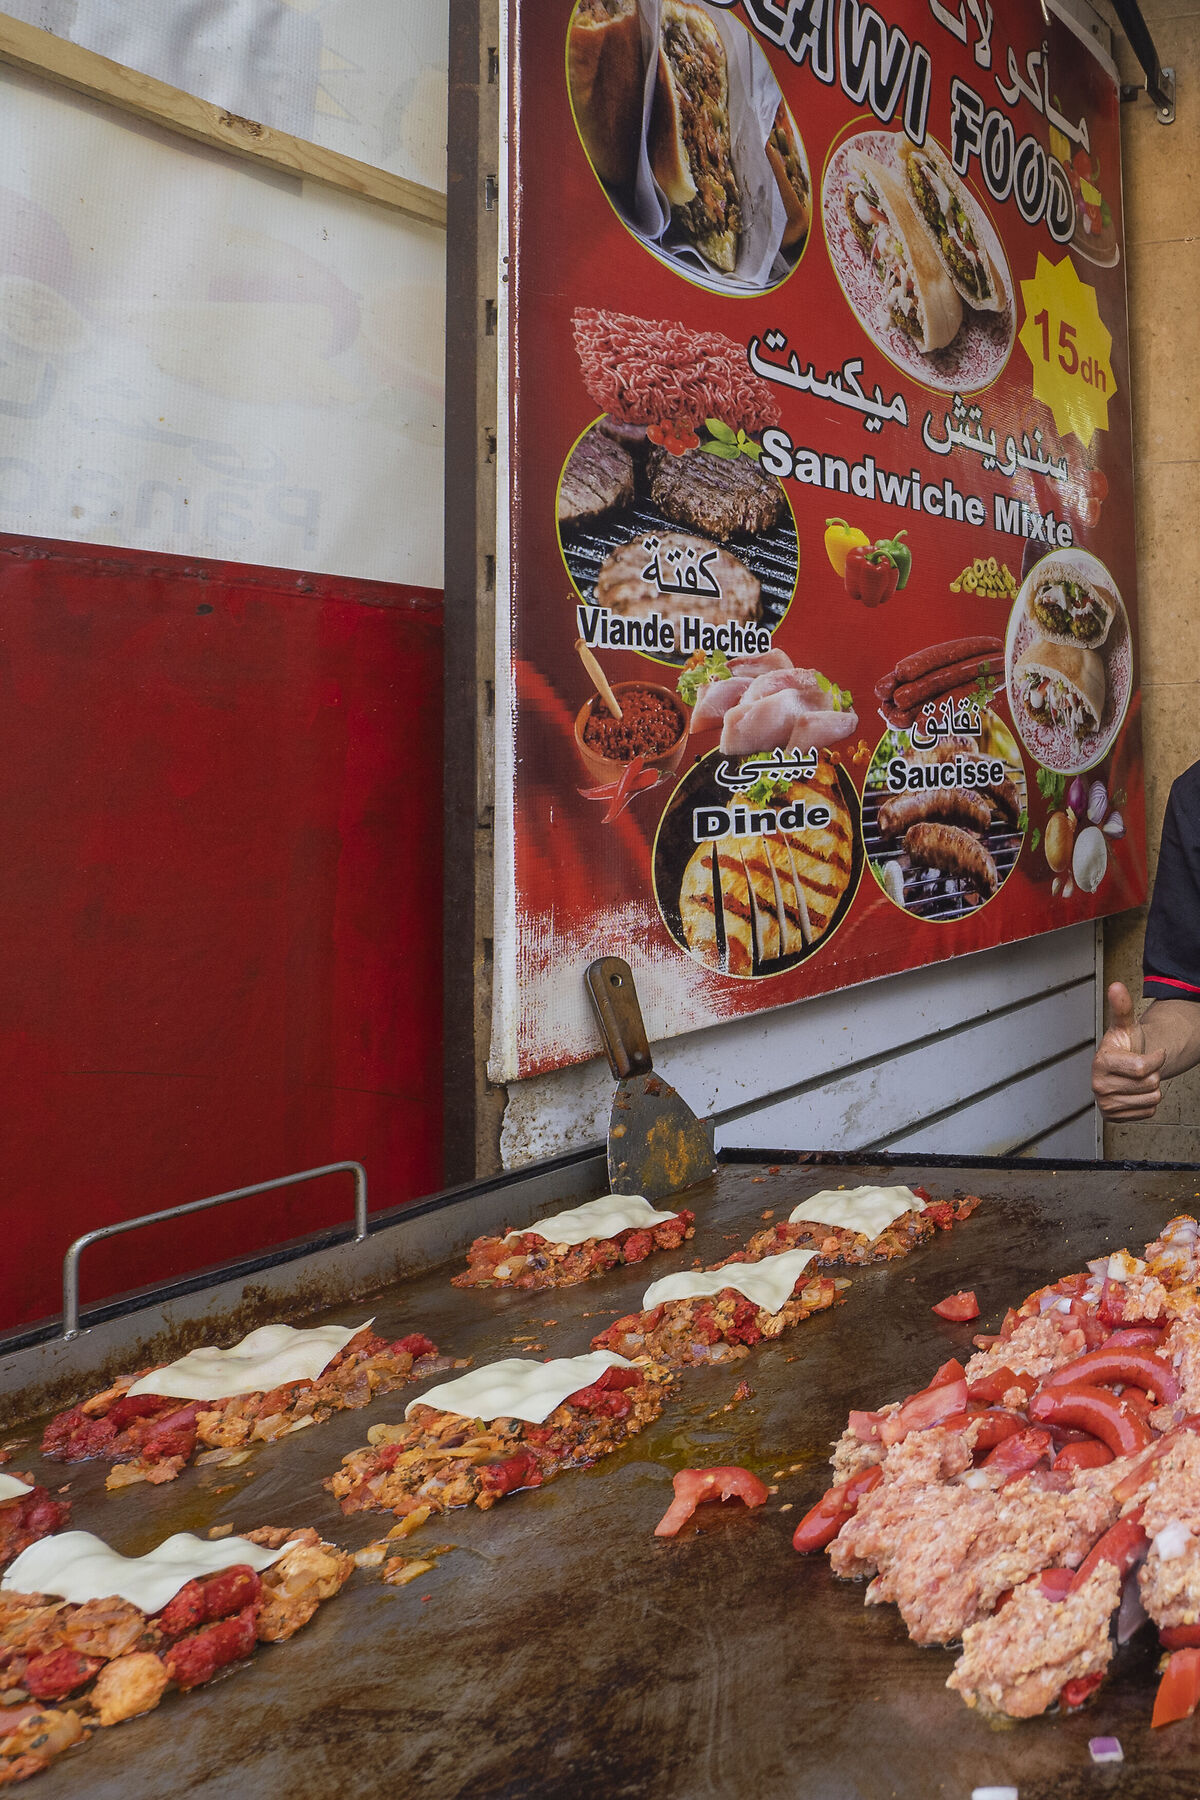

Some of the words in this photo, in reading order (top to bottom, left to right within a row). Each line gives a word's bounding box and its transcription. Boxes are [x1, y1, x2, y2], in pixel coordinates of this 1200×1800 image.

[951, 77, 1076, 243] FOOD
[749, 330, 908, 432] ميكست
[922, 394, 1069, 481] سندويتش
[760, 427, 986, 526] Sandwiche
[995, 493, 1074, 548] Mixte
[641, 536, 722, 598] كفتة
[577, 605, 675, 650] Viande
[682, 615, 771, 654] Hachée
[911, 696, 983, 750] نقانق
[716, 747, 818, 791] بيبي
[888, 756, 1004, 792] Saucisse
[694, 801, 831, 842] Dinde
